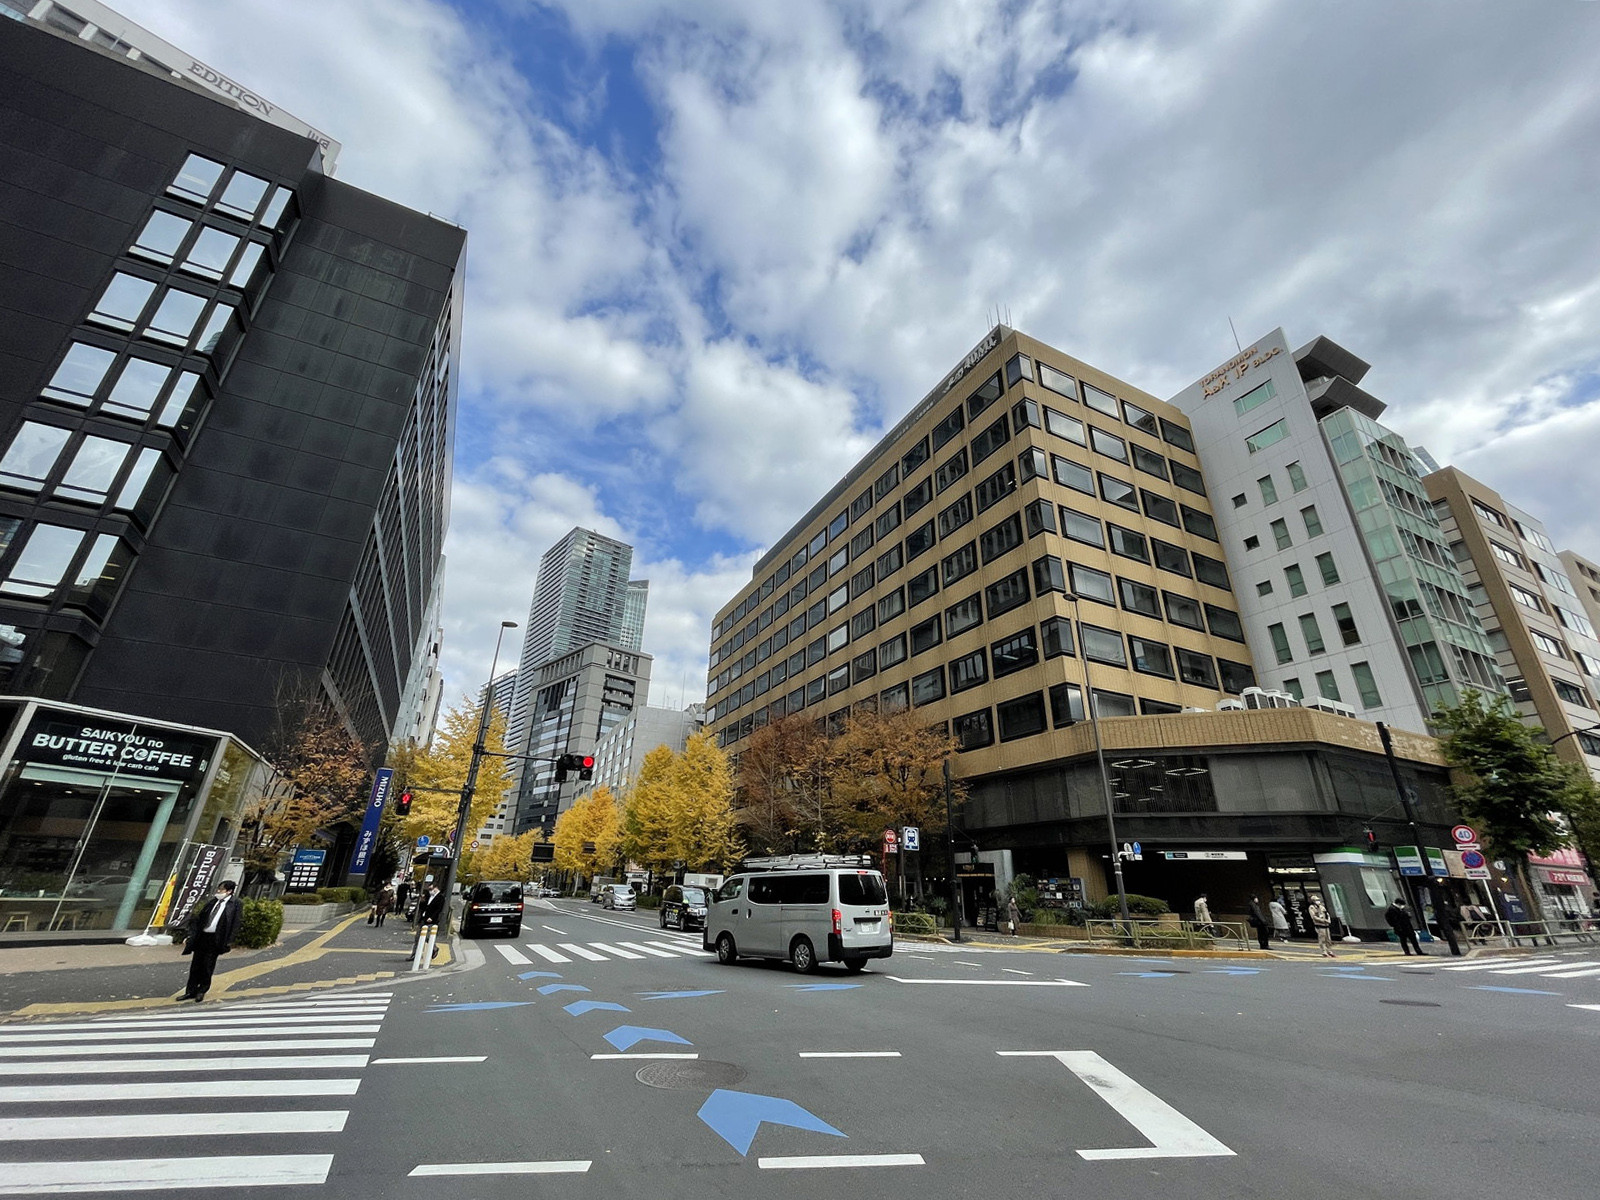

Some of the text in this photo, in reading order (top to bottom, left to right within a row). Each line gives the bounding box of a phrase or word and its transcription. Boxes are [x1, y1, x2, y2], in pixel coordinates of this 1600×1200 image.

[187, 61, 274, 118] EDITION
[1199, 347, 1258, 388] TORANOMON
[1235, 362, 1249, 380] IP
[32, 733, 194, 768] BUTTER COFFEE
[80, 727, 164, 749] SAIKYOU no
[62, 753, 88, 762] gluten
[88, 757, 105, 765] free
[127, 762, 143, 770] carb
[373, 776, 389, 808] MIZUHO
[1458, 830, 1471, 839] 40
